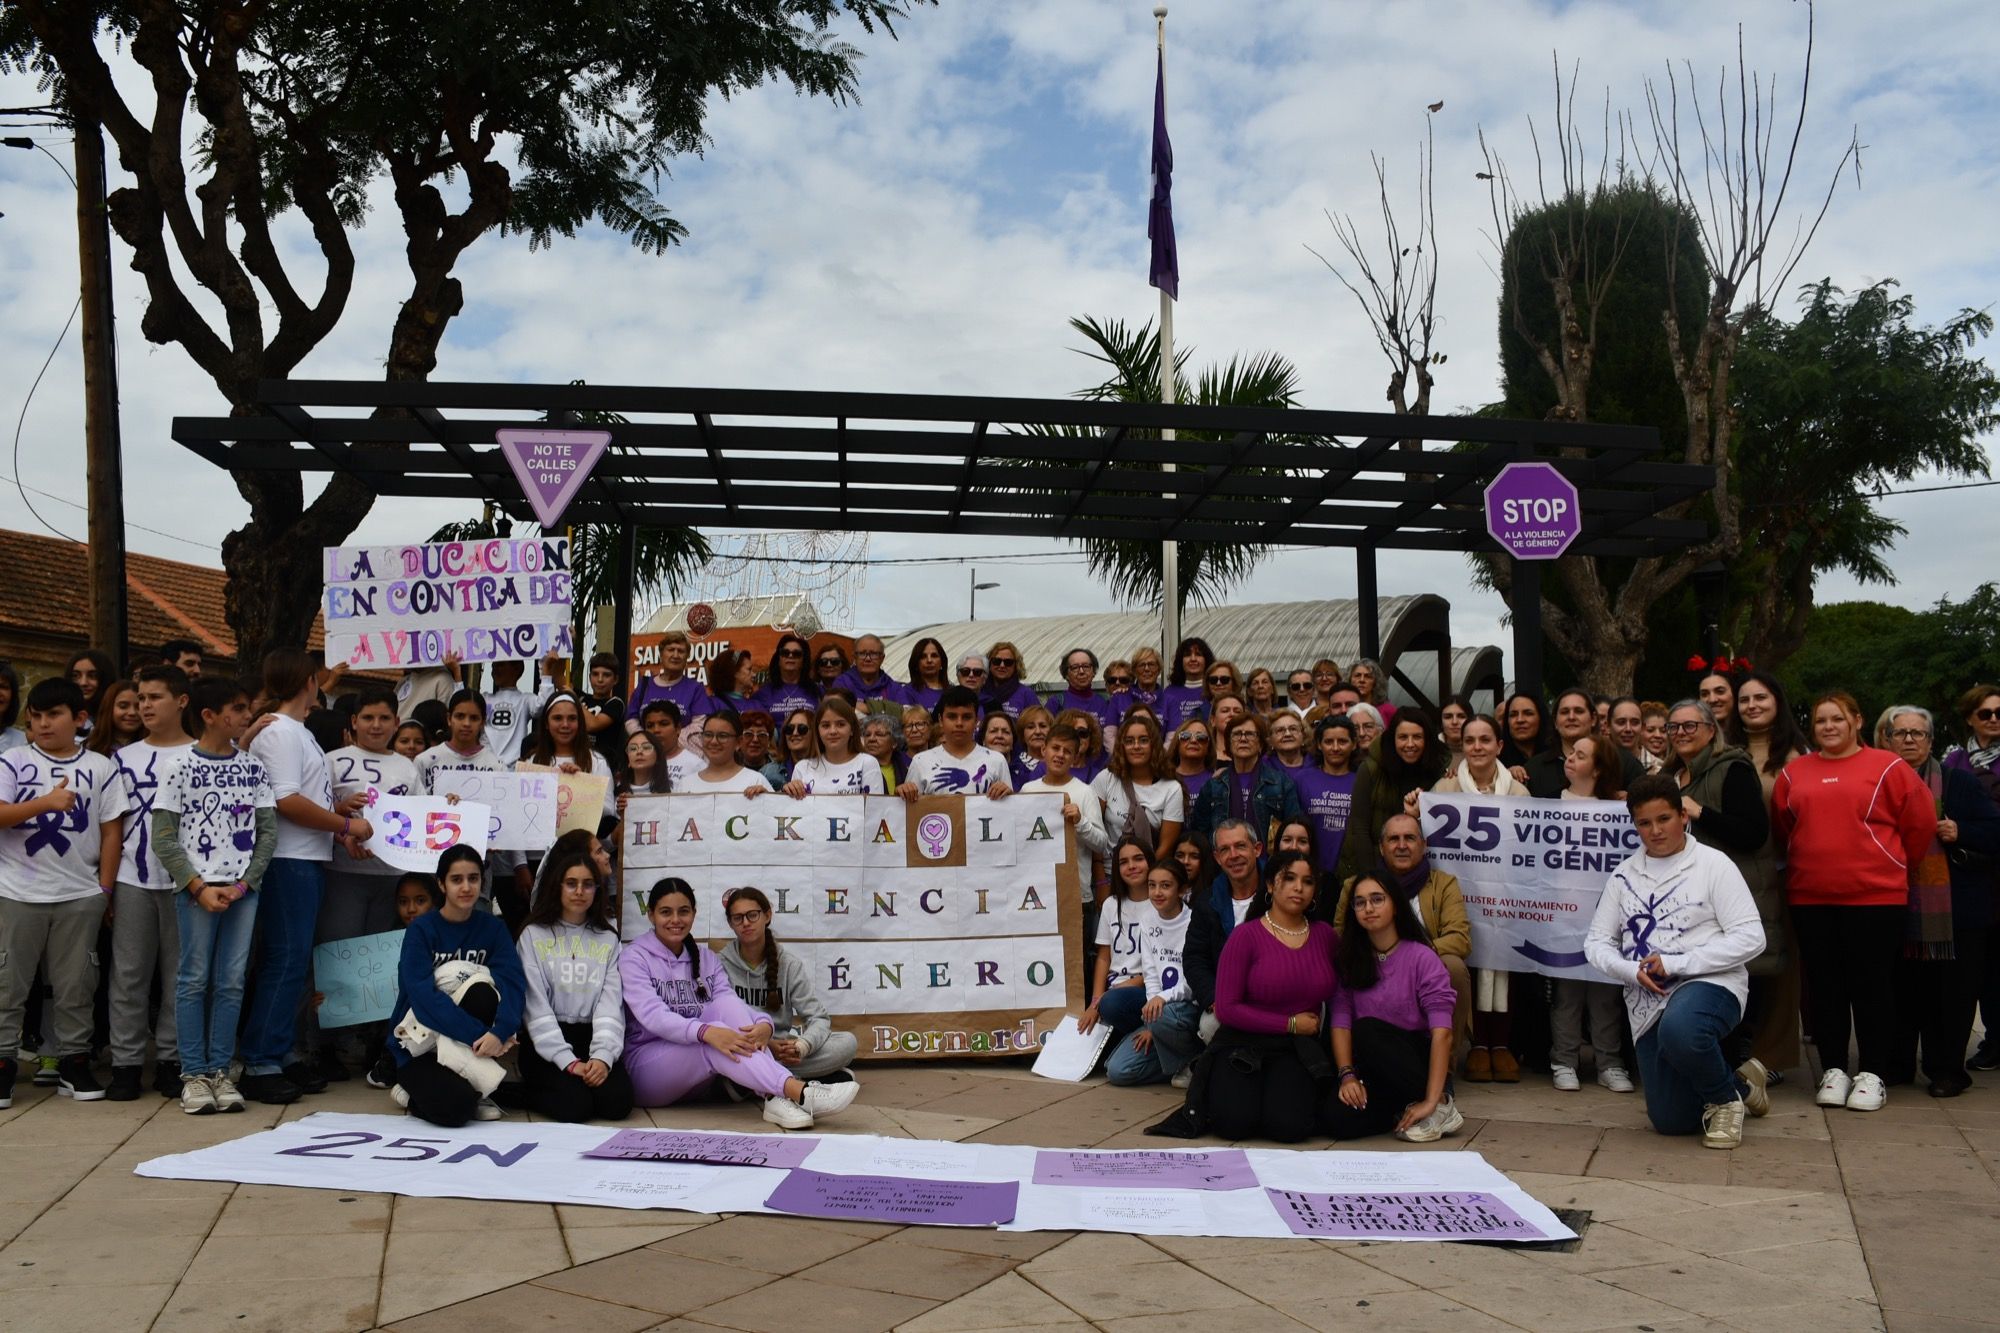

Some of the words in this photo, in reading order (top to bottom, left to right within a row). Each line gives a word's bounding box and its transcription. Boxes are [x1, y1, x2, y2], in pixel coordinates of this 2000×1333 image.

[534, 445, 551, 456] NO
[556, 445, 572, 456] TE
[527, 458, 576, 470] CALLES
[540, 473, 561, 485] 016
[1503, 498, 1567, 524] STOP
[1504, 531, 1511, 539] A
[1512, 531, 1523, 539] LA
[1524, 530, 1566, 539] VIOLENCIA
[1513, 540, 1524, 548] DE
[1526, 538, 1560, 548] GÉNERO
[329, 549, 375, 581] LA
[380, 540, 569, 580] DUCACION
[326, 586, 377, 620] EN
[386, 576, 521, 616] CONTRA
[529, 572, 571, 606] DE
[380, 624, 573, 665] VIOLENCIA
[336, 757, 382, 784] 25
[848, 770, 863, 786] 25
[520, 777, 548, 800] DE
[1514, 808, 1539, 820] SAN
[1544, 810, 1588, 822] ROQUE
[383, 810, 462, 850] 25
[979, 815, 1055, 842] LA
[1426, 803, 1501, 851] 25
[1440, 850, 1501, 863] noviembre
[1512, 854, 1535, 867] DE
[1498, 898, 1578, 912] AYUNTAMIENTO
[1482, 908, 1493, 917] DE
[1496, 909, 1515, 919] SAN
[1519, 911, 1555, 922] ROQUE
[274, 1131, 540, 1168] 25N
